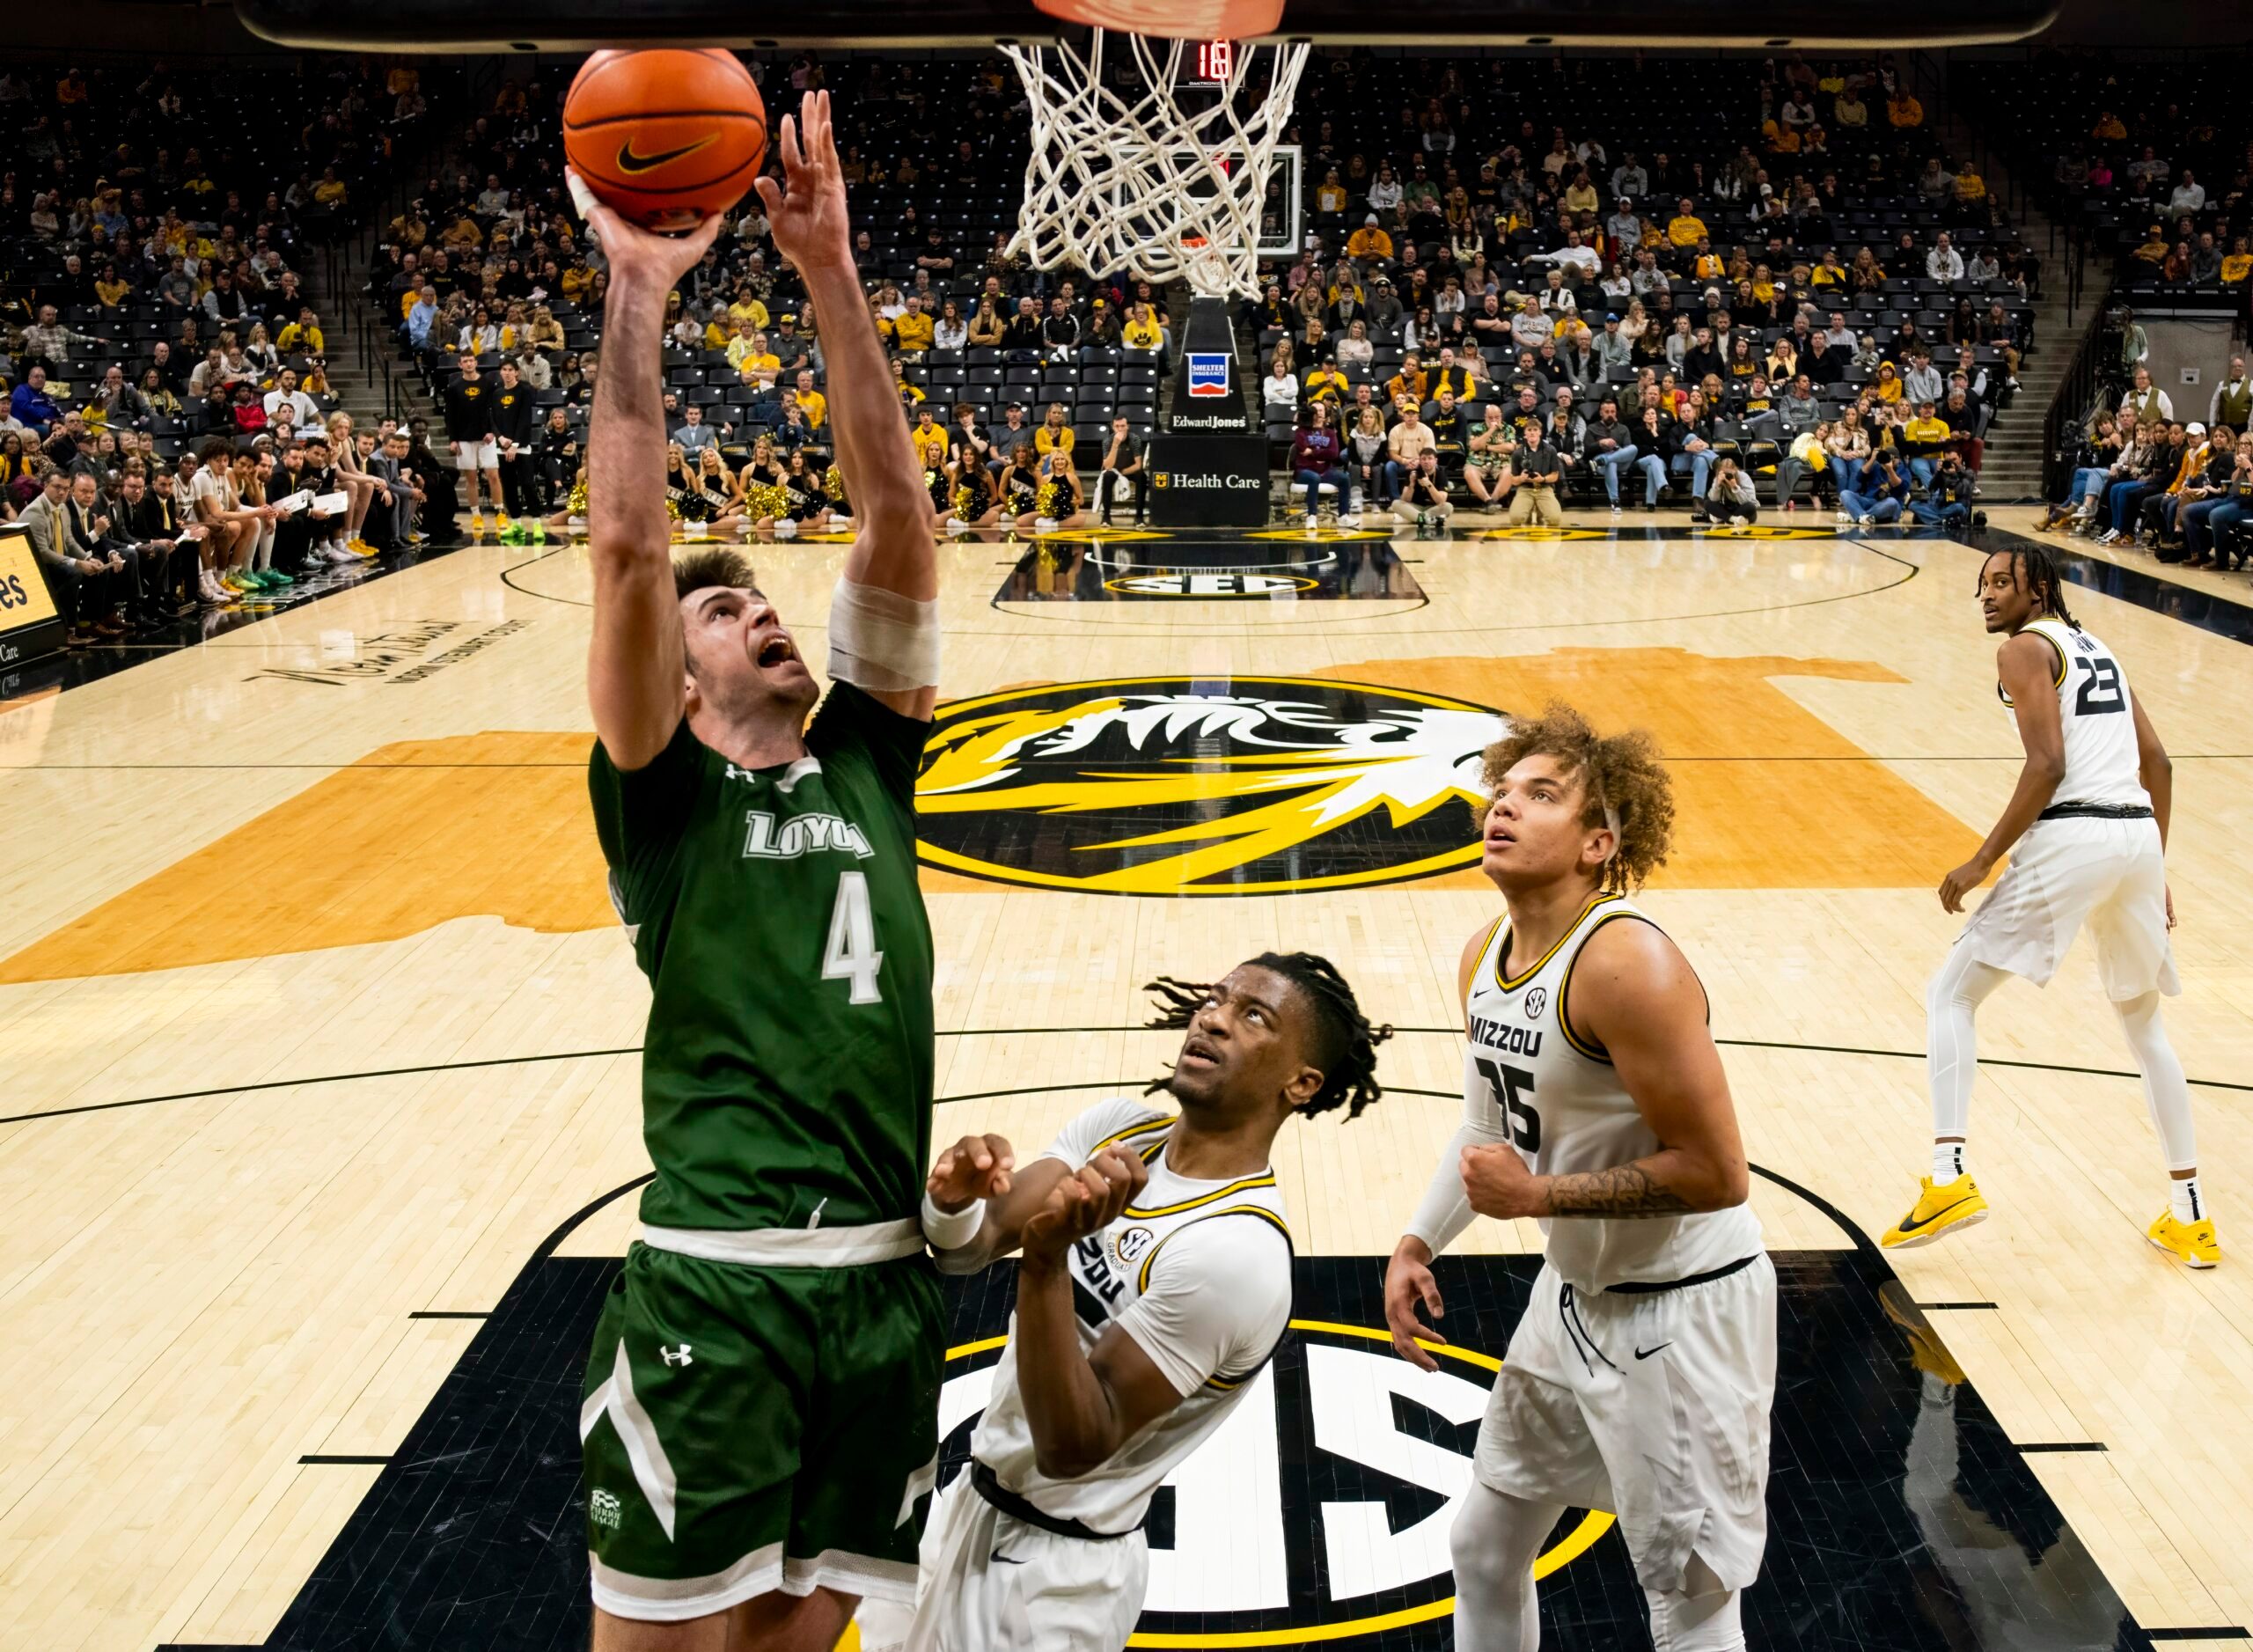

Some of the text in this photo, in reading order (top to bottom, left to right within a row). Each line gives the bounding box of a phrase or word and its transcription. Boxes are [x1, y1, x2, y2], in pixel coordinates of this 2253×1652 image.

[1173, 474, 1222, 488] Health
[1225, 474, 1260, 488] Care
[1124, 574, 1297, 594] SEC
[0, 643, 19, 663] Care
[384, 664, 448, 684] NORM
[426, 637, 501, 664] STEWART
[2074, 657, 2126, 716] 23
[742, 810, 876, 860] LOYO
[821, 870, 884, 1005] 4
[1526, 988, 1546, 1019] SEC
[1470, 1014, 1543, 1058] MIZZOU
[1119, 1228, 1154, 1261] SE
